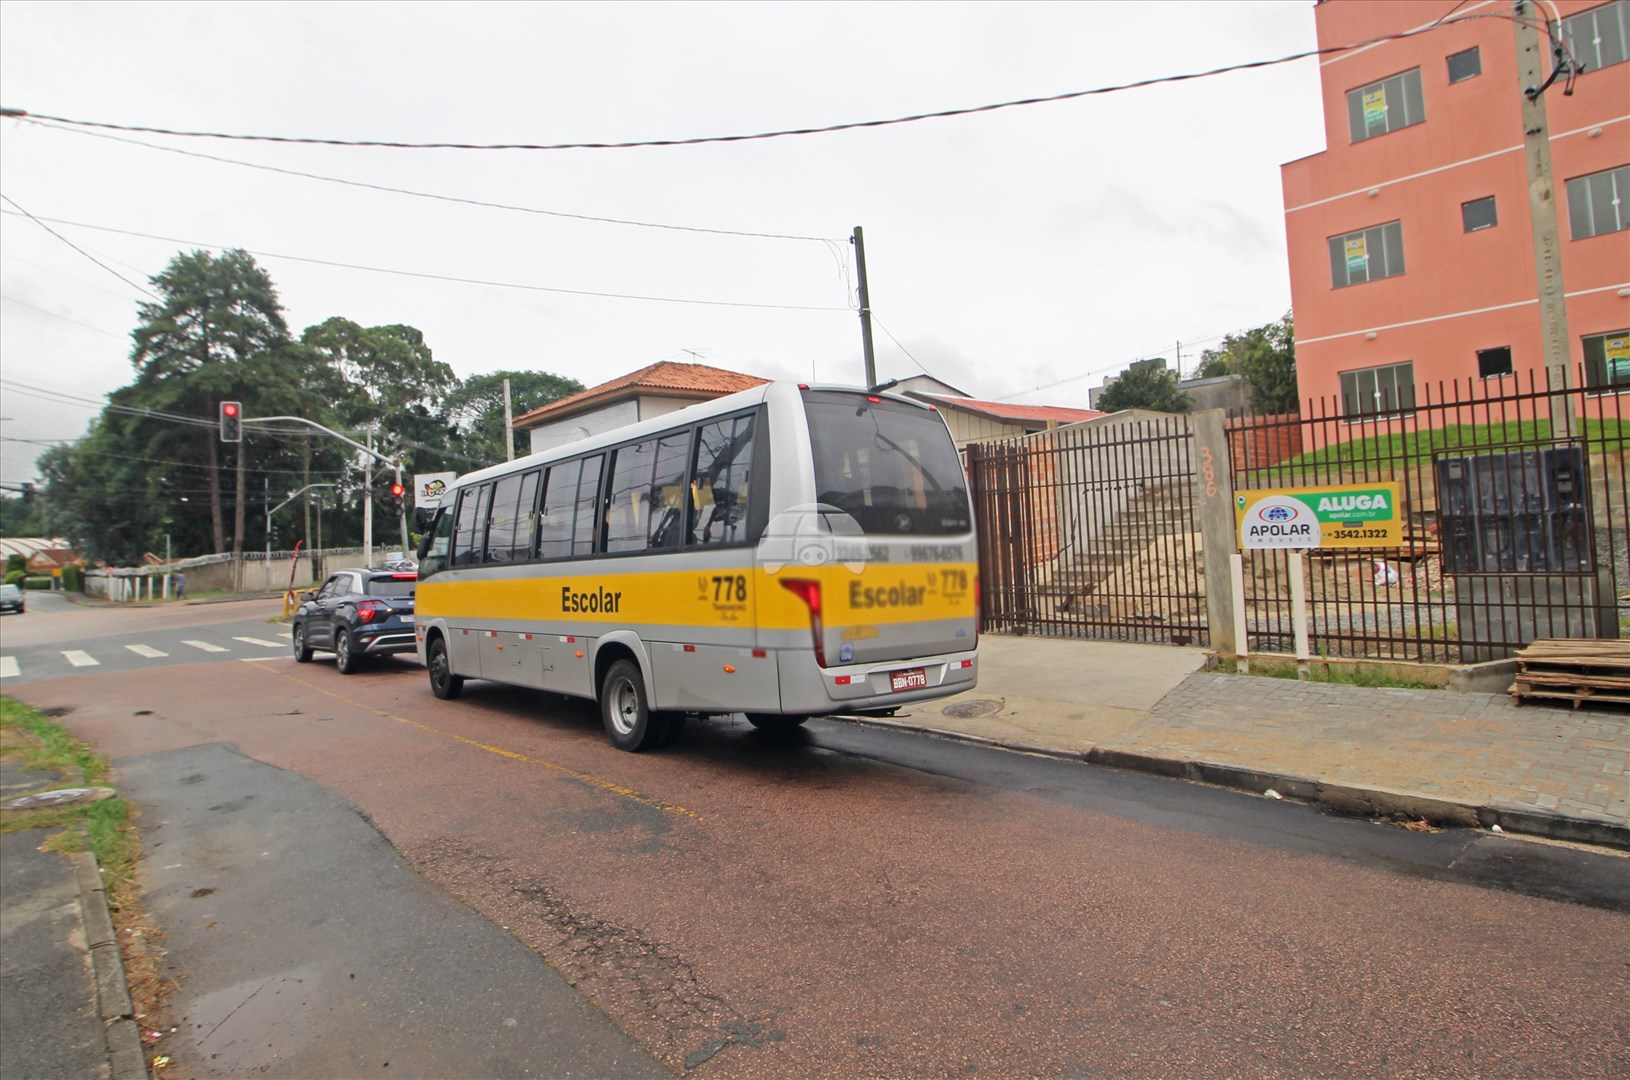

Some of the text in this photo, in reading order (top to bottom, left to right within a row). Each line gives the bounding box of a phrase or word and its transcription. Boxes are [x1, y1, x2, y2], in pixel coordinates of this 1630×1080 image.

[1318, 494, 1388, 512] ALUGA
[1329, 511, 1376, 519] apolar.com.br
[1250, 524, 1310, 536] APOLAR
[1334, 529, 1388, 539] 3542.1322
[712, 574, 747, 602] 778
[941, 570, 967, 591] 778
[562, 586, 621, 613] Escolar
[849, 580, 925, 609] Escolar
[893, 674, 925, 689] BBN-0778
